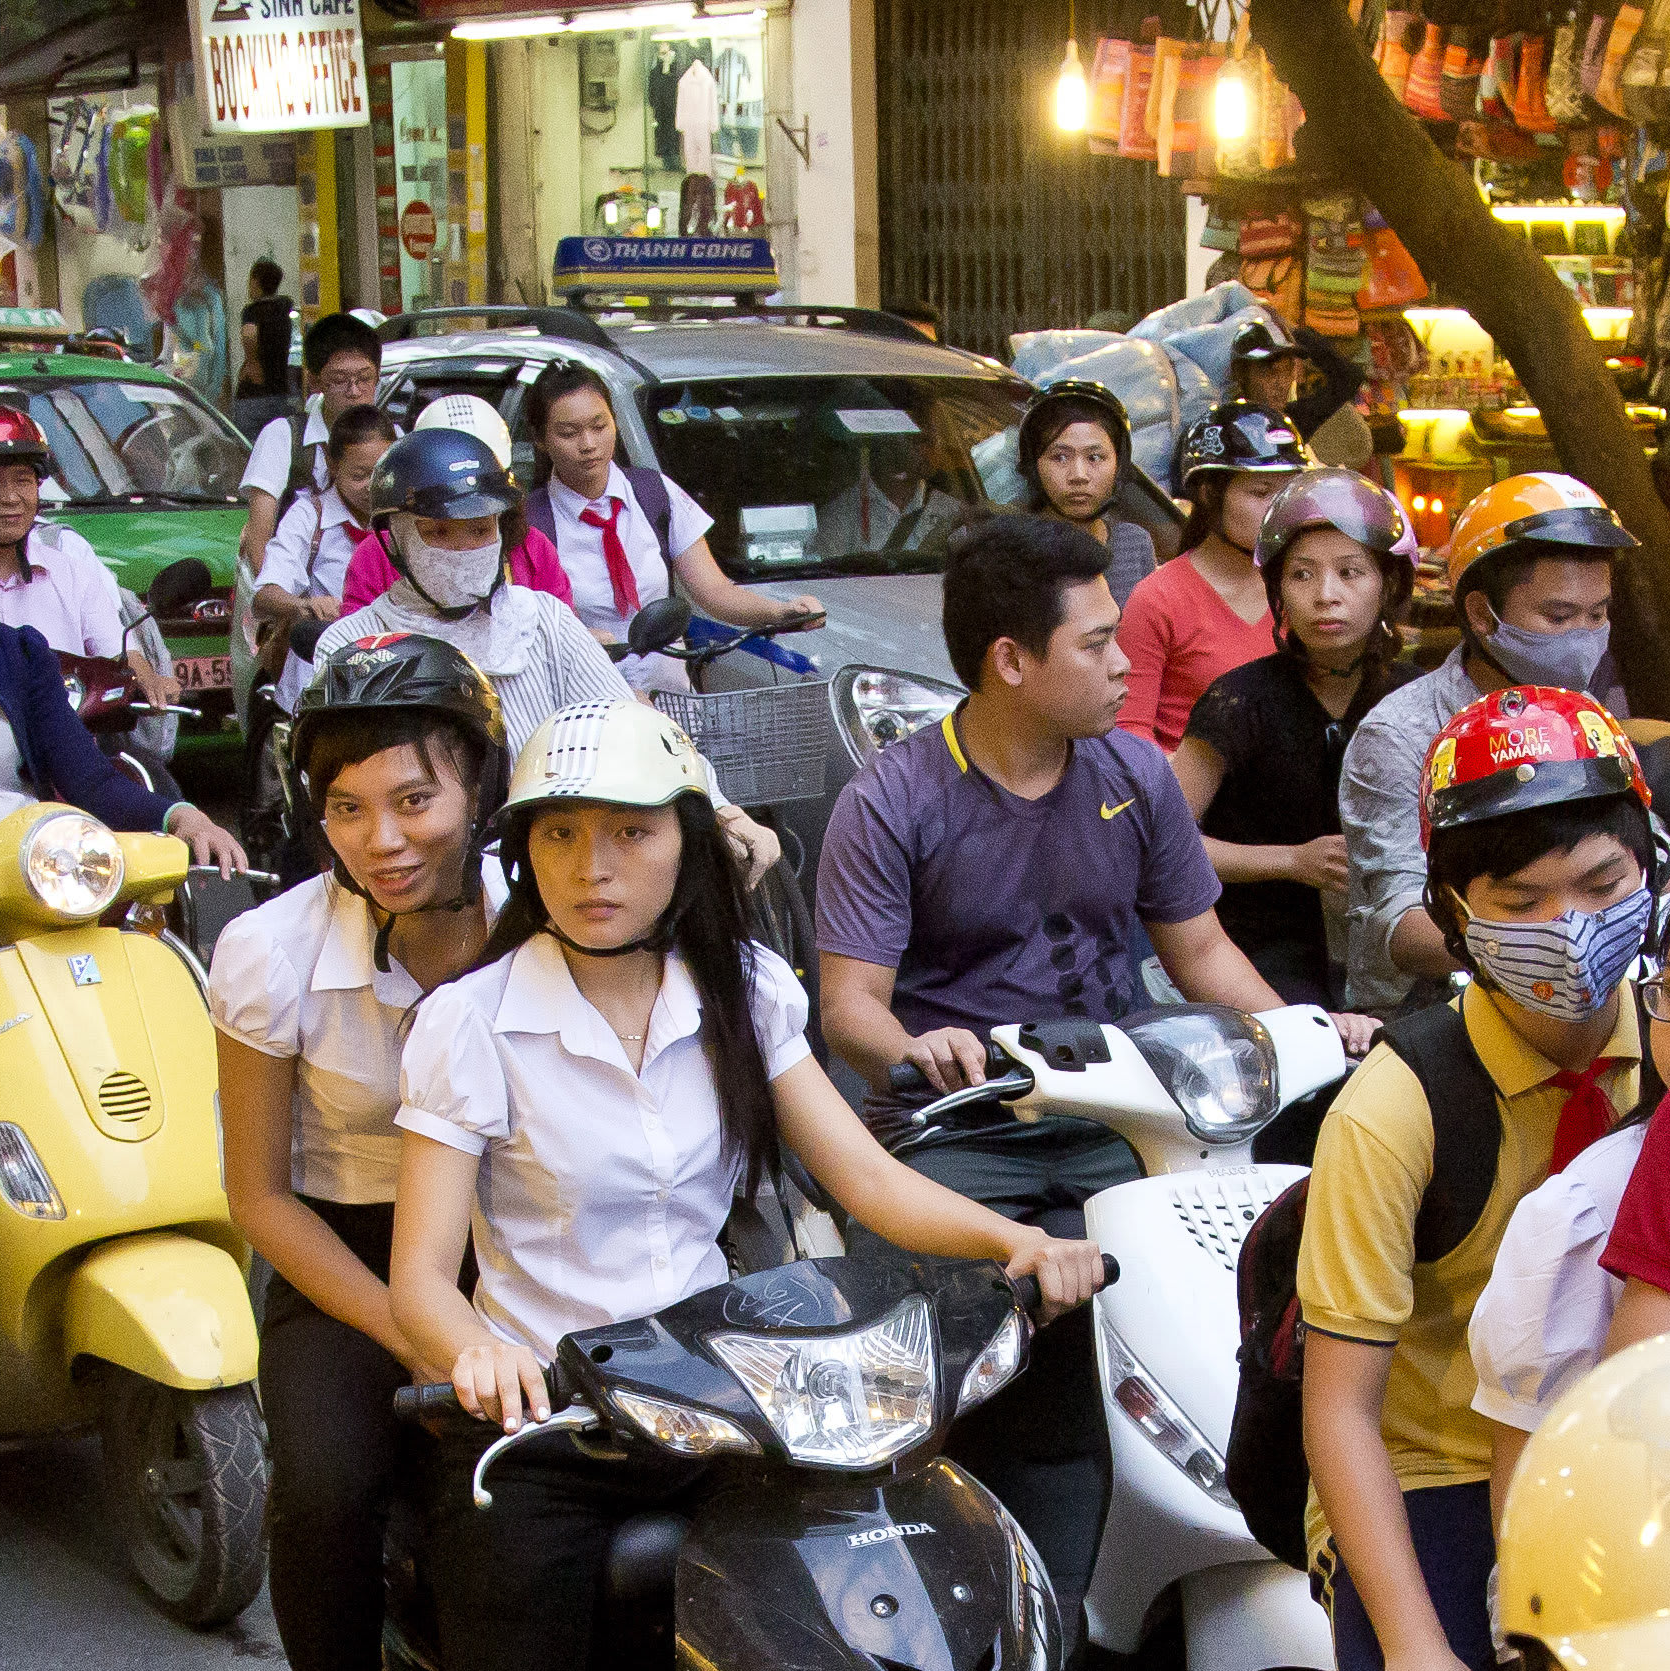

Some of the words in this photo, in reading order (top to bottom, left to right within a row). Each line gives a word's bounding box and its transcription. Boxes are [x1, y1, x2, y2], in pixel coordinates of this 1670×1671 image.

[210, 33, 295, 121] BOOKING
[298, 28, 362, 116] OFFICE
[1489, 726, 1551, 752] MORE
[1490, 742, 1553, 764] YAMAHA
[846, 1521, 936, 1549] HONDA
